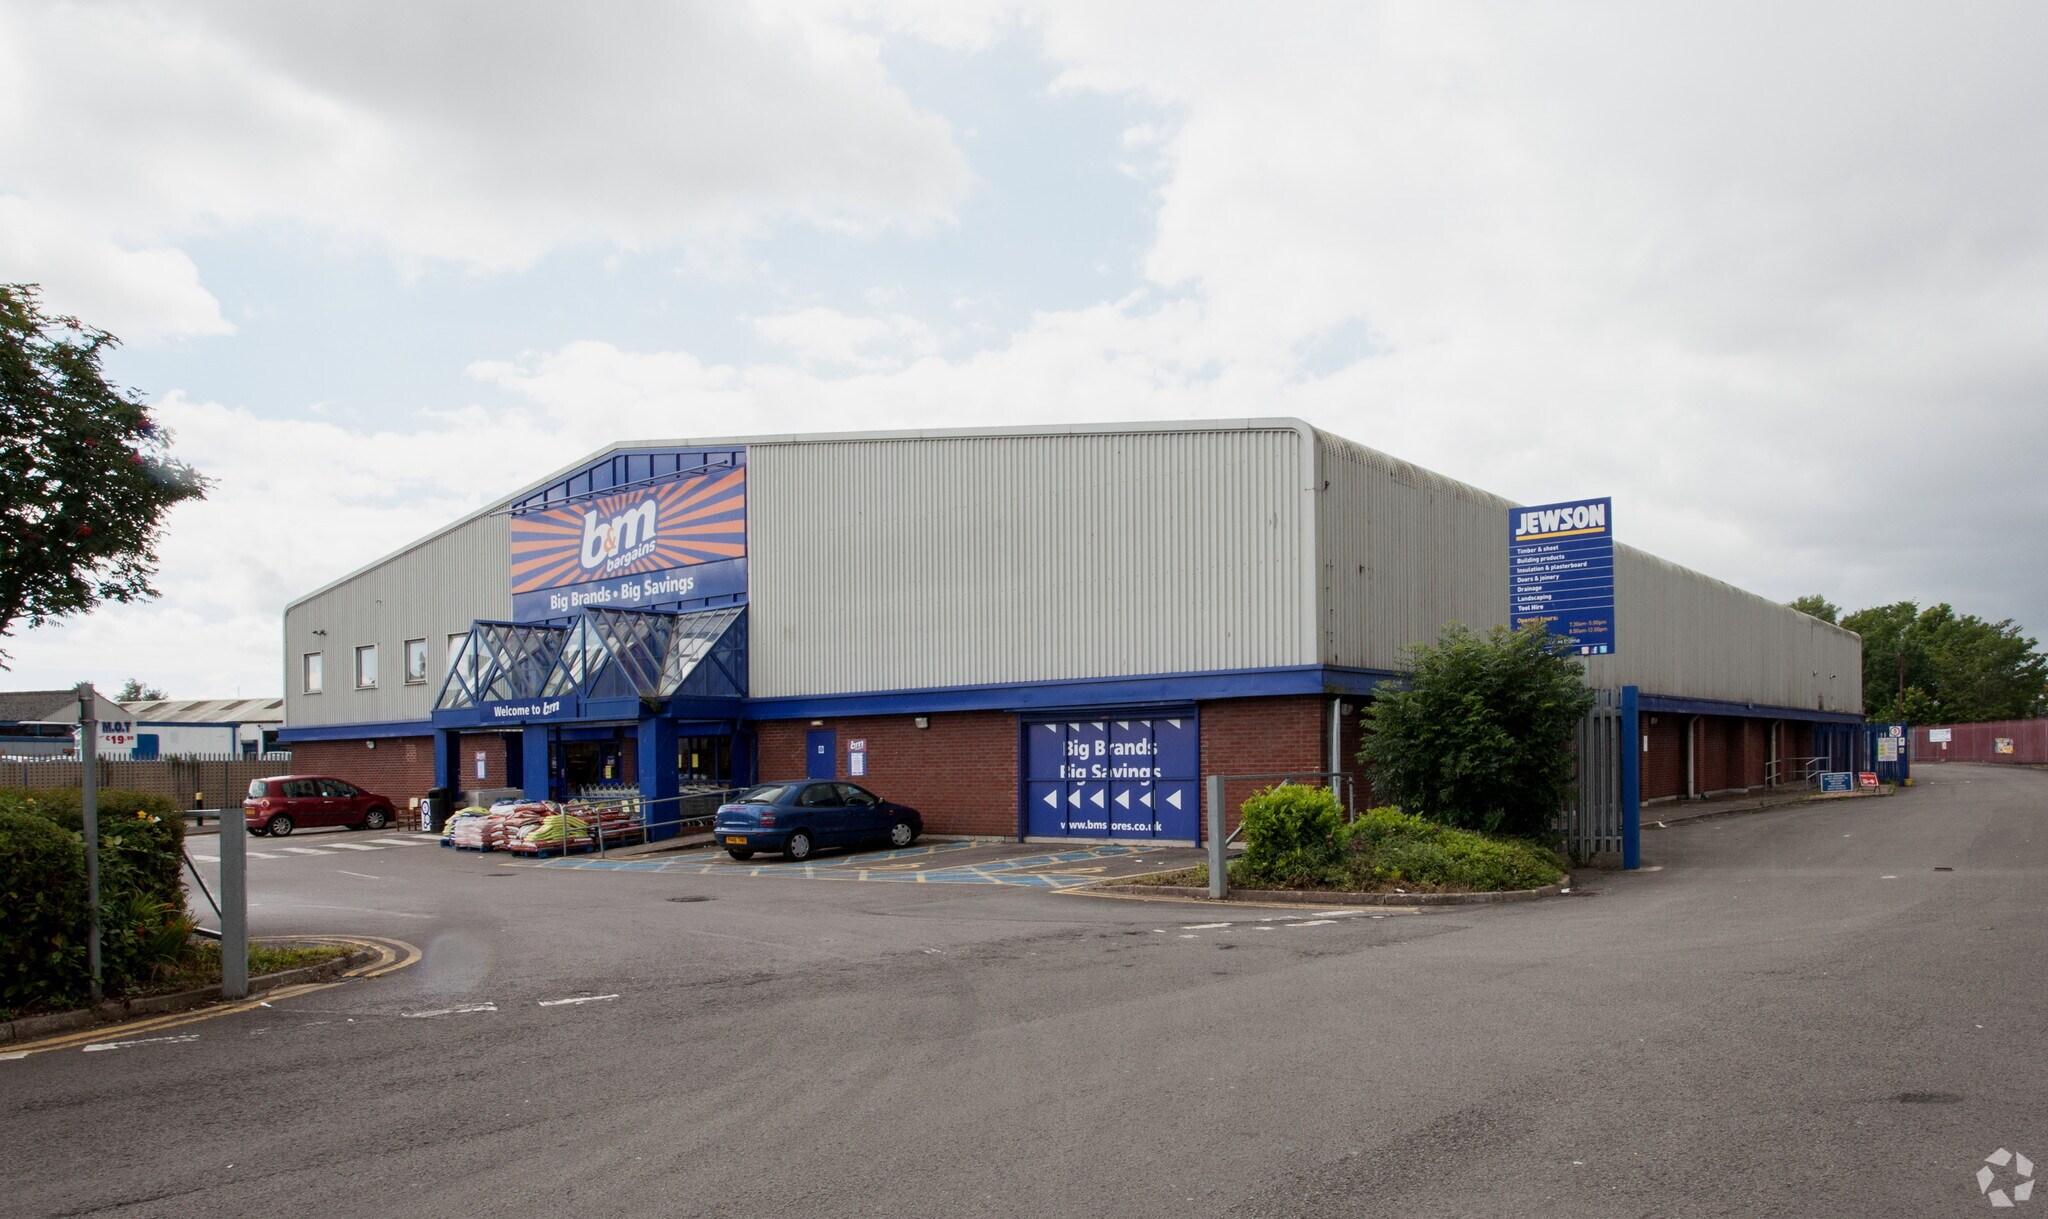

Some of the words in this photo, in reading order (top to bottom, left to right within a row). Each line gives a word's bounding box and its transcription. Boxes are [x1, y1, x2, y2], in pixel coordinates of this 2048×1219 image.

[1516, 503, 1605, 535] JEWSON
[581, 499, 657, 569] b&m
[607, 539, 656, 573] bargains
[1540, 554, 1565, 562] products
[1551, 561, 1588, 571] plasterboard
[1540, 574, 1559, 582] joinery
[550, 593, 568, 612] Big
[571, 586, 611, 607] Brands
[621, 582, 640, 602] Big
[644, 576, 694, 595] Savings
[1517, 594, 1552, 602] Landscaping
[494, 705, 530, 717] Welcome
[531, 704, 541, 715] to
[102, 721, 132, 733] M.O.T
[1063, 739, 1090, 761] Big
[1095, 737, 1158, 756] Brands
[1060, 763, 1087, 786] Big
[1091, 762, 1162, 786] Savings
[1060, 819, 1162, 832] www.bmsores.co.uk
